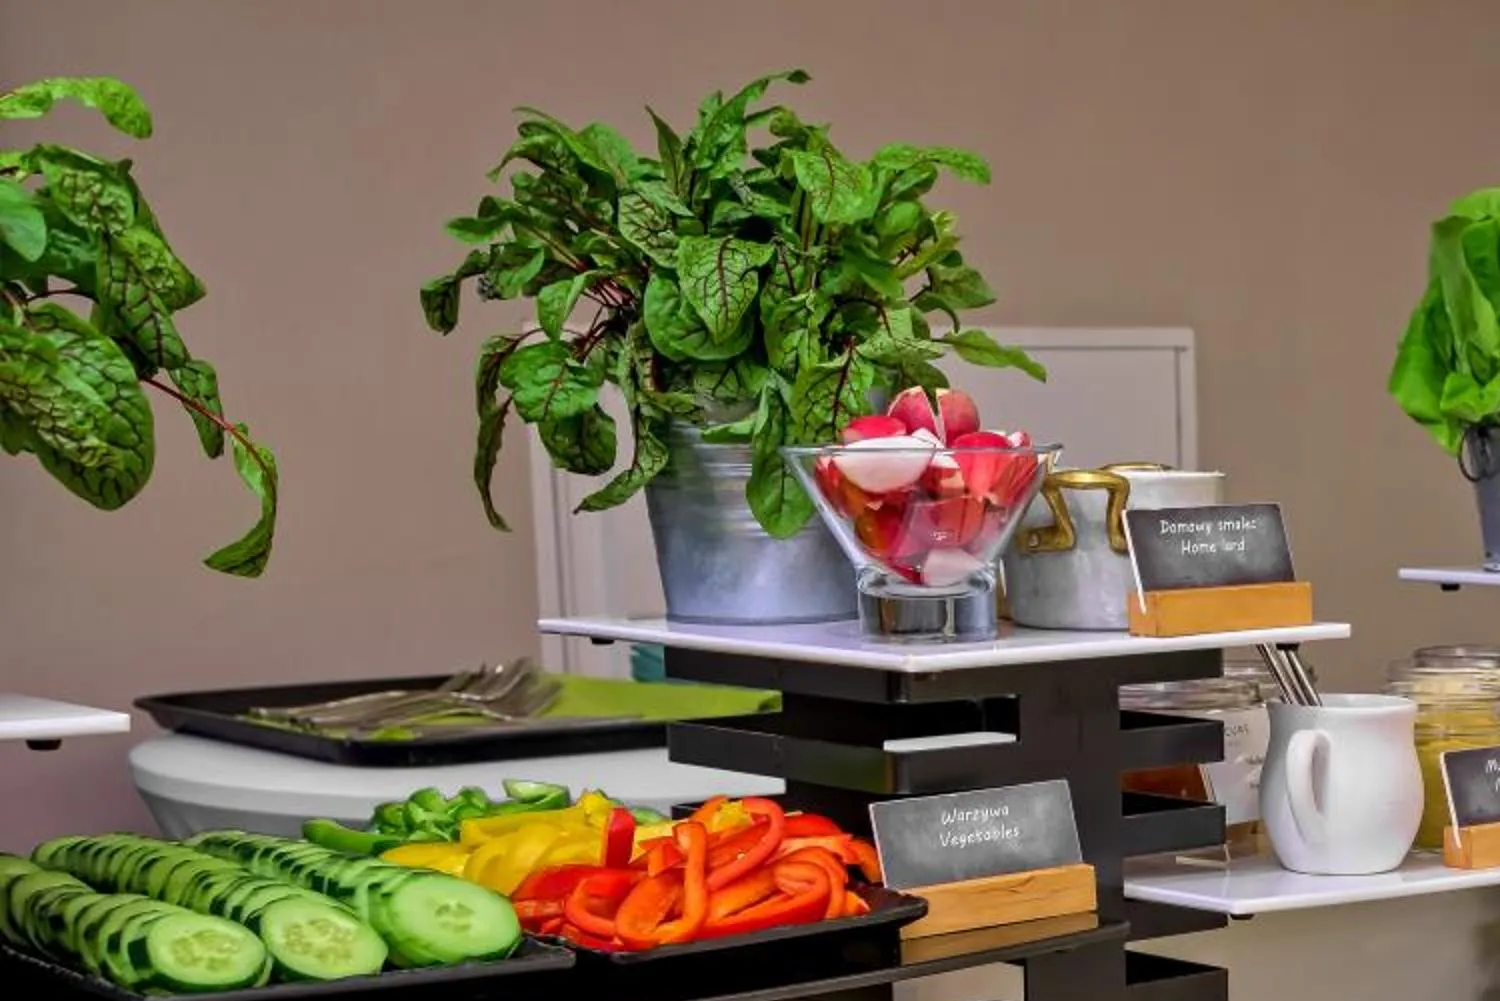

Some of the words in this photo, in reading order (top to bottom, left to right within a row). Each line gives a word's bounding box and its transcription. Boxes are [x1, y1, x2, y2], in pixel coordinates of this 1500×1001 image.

[1181, 539, 1216, 555] Home
[942, 806, 1009, 825] Warzywa
[940, 823, 1020, 849] Vegetables
